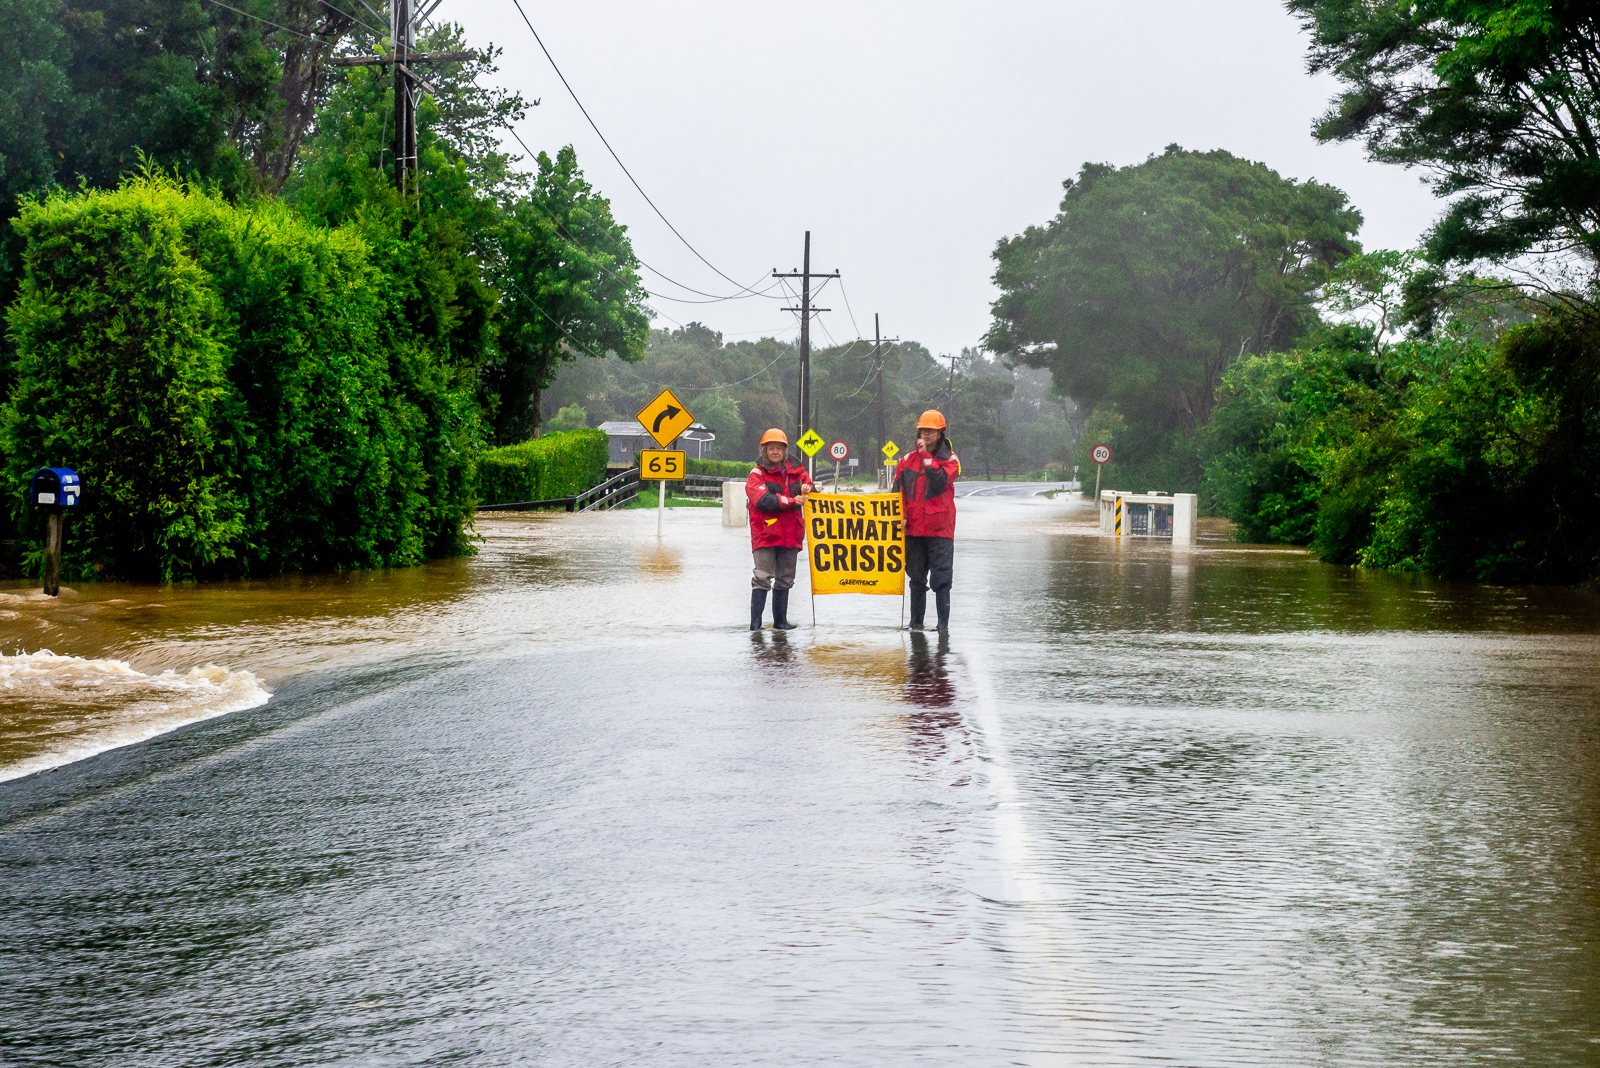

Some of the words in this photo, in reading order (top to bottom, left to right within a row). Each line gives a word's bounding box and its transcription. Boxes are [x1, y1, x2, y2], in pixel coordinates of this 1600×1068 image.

[834, 446, 845, 454] 80
[1096, 450, 1108, 458] 80
[648, 456, 677, 473] 65
[808, 499, 846, 514] THIS
[850, 501, 866, 516] IS
[870, 500, 900, 516] THE
[812, 518, 902, 541] CLIMATE
[814, 543, 902, 572] CRISIS
